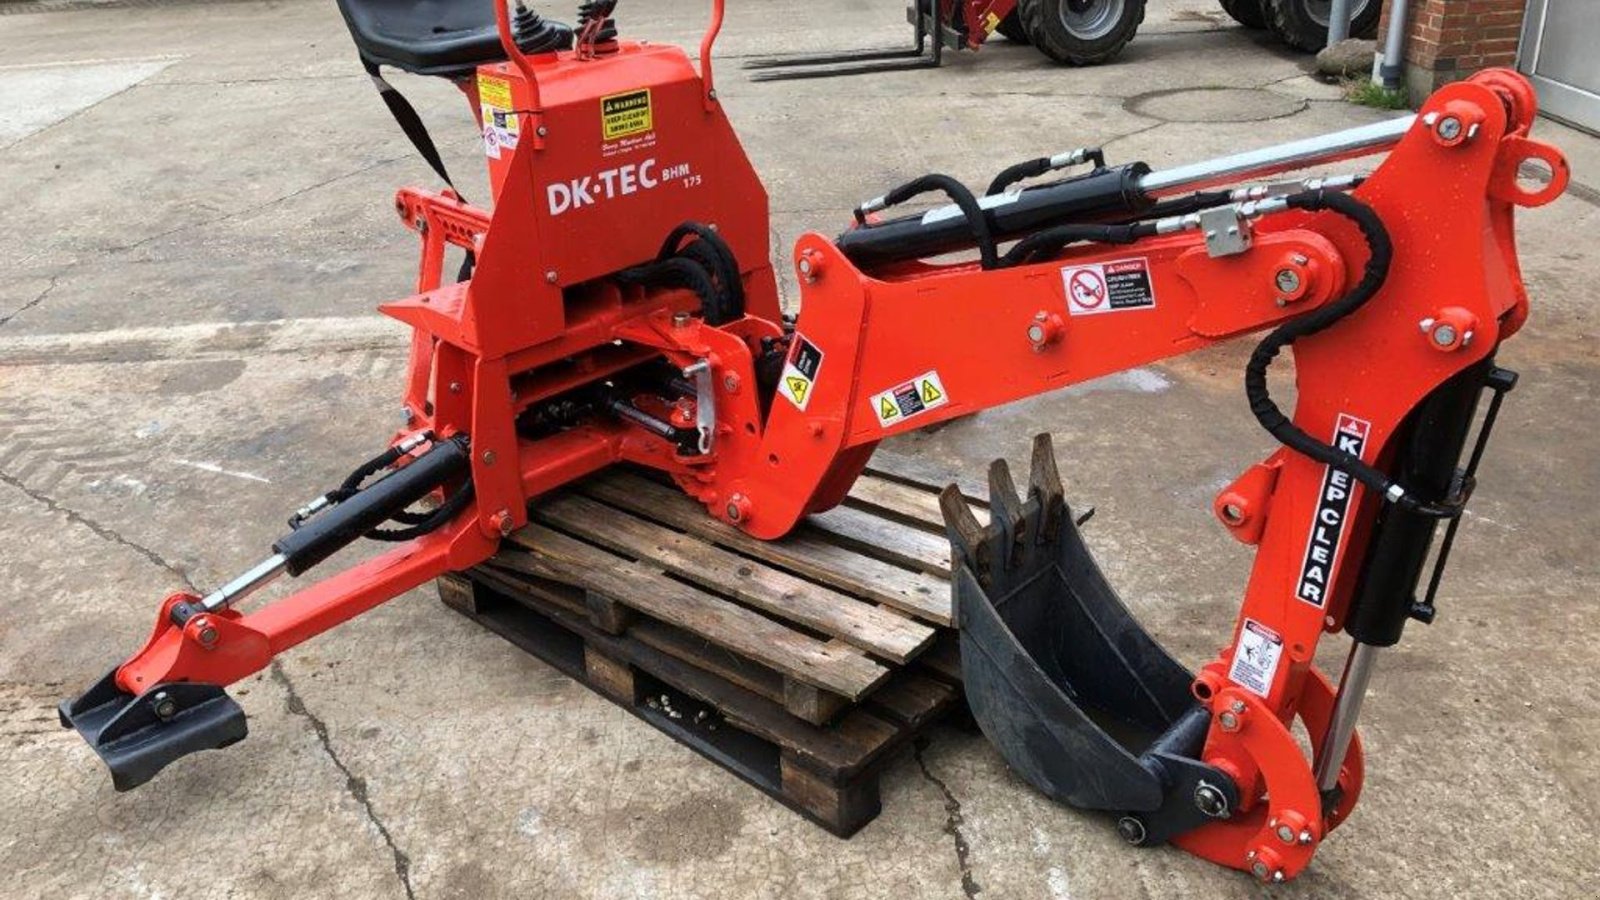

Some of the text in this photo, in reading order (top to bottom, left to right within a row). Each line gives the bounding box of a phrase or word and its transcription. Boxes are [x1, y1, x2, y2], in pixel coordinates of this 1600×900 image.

[662, 163, 691, 181] BHM
[683, 174, 702, 188] 175
[1326, 435, 1360, 502] KEP
[1302, 508, 1340, 601] CLEAR
